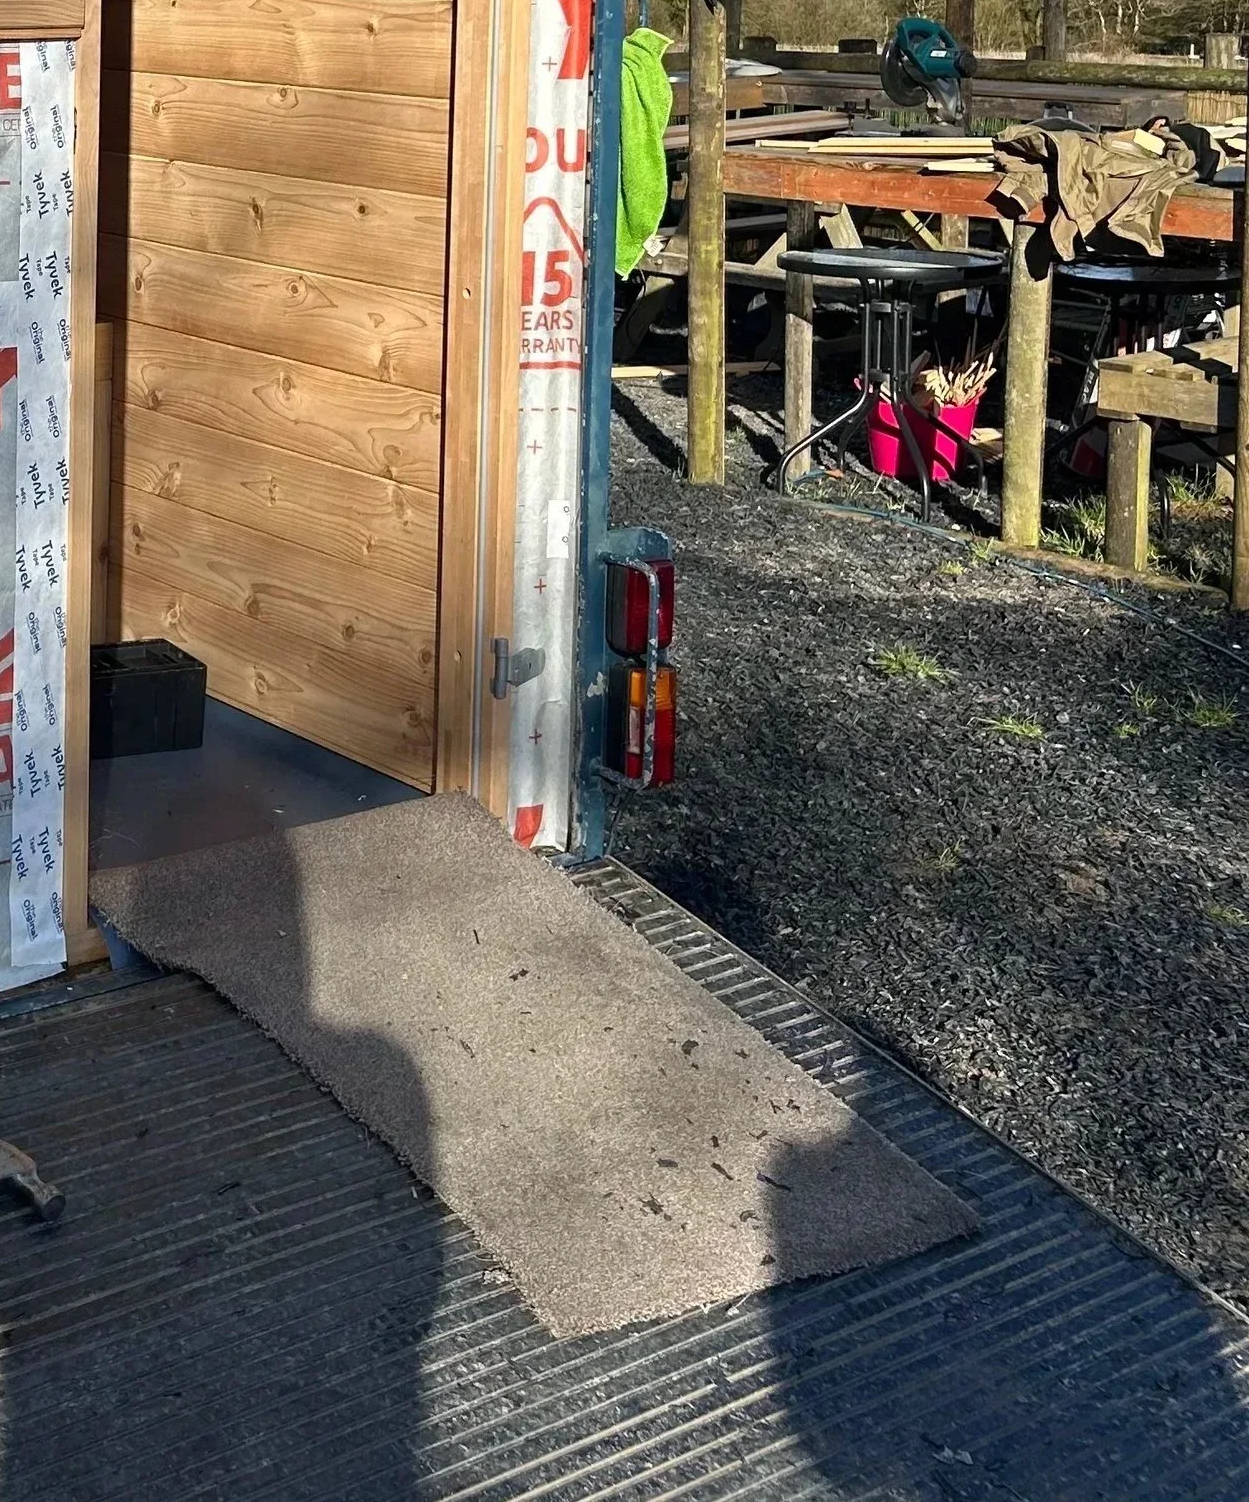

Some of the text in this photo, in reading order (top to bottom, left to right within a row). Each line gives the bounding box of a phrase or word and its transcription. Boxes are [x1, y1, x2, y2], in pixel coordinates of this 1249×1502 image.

[33, 169, 50, 219] Tyvek
[19, 253, 35, 301] Tyvek
[44, 251, 63, 300] Tyvek
[30, 321, 45, 363] Original
[521, 310, 574, 331] EARS
[520, 337, 582, 354] RRANTY
[19, 399, 32, 442] Original
[46, 396, 60, 438] Original
[27, 460, 46, 510] Tyvek
[16, 544, 32, 594] Tyvek
[40, 540, 60, 588] Tyvek
[28, 612, 42, 653] Original
[14, 689, 28, 732] Original
[42, 683, 56, 726] Original
[24, 747, 42, 798] Tyvek
[12, 834, 29, 882] Tyvek
[37, 826, 55, 875] Tyvek
[23, 899, 38, 941] Original
